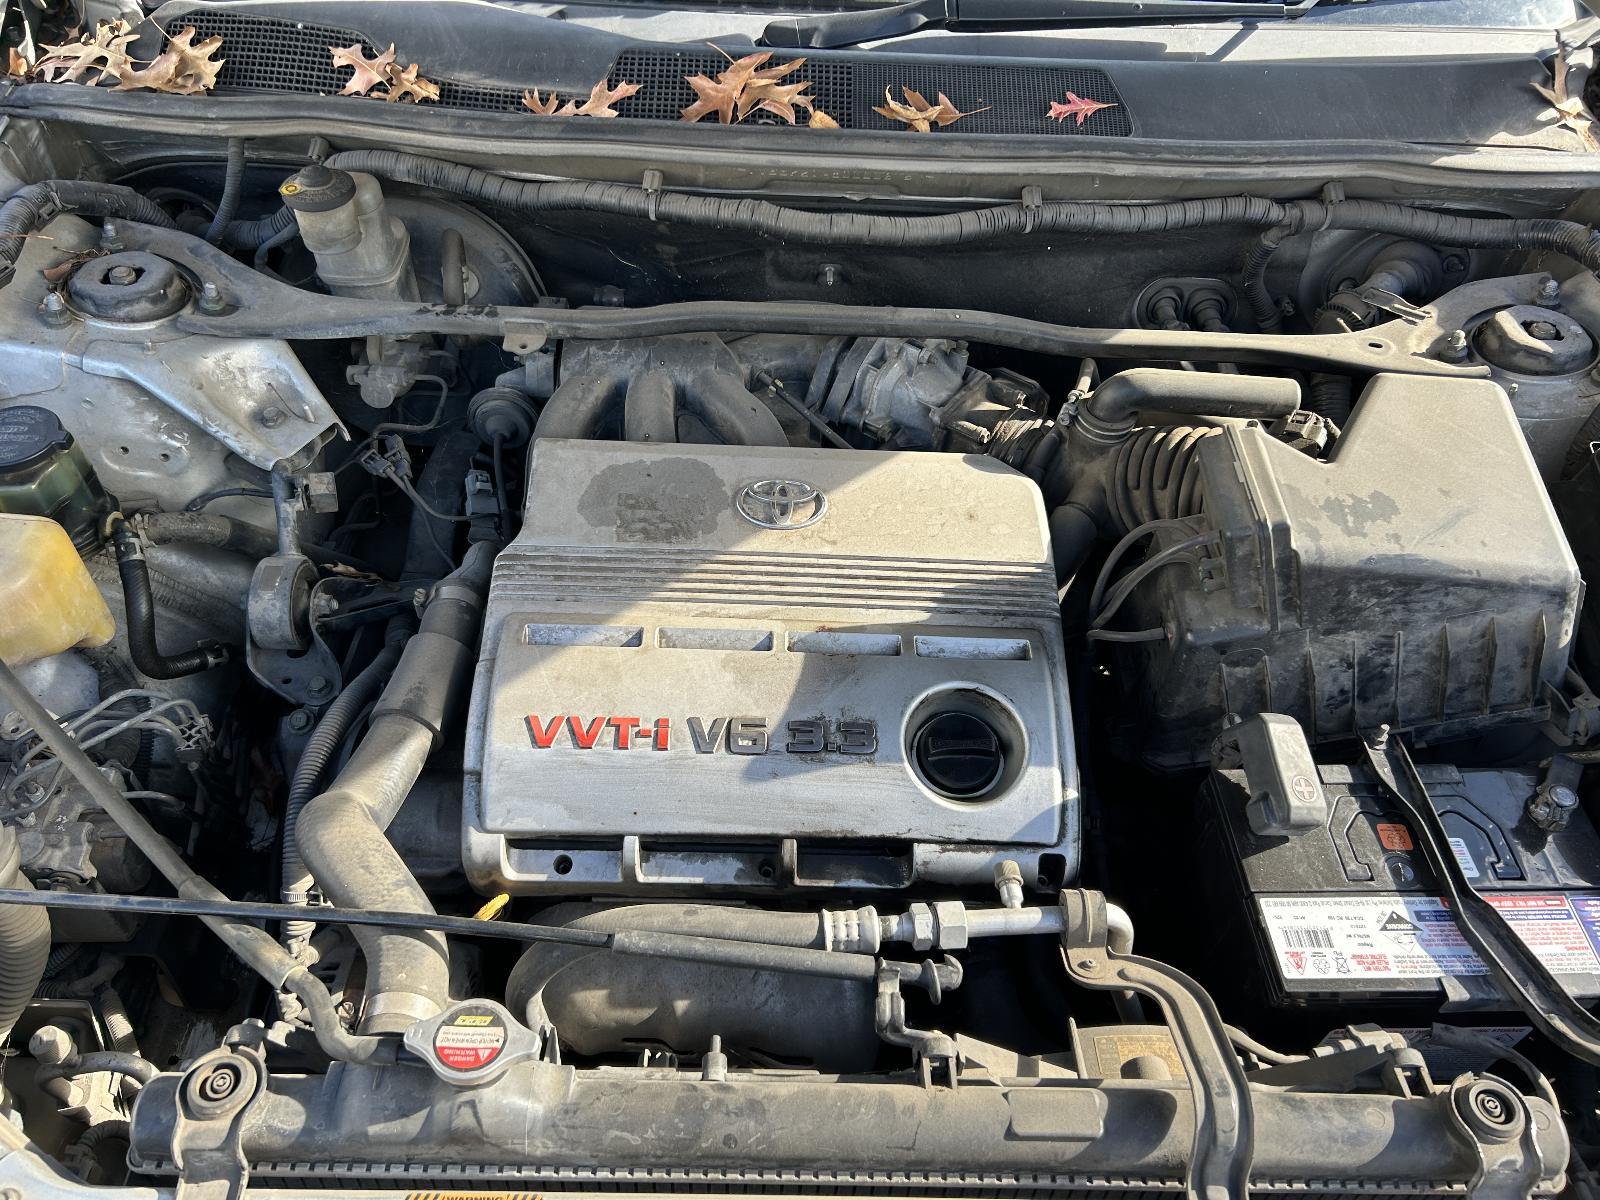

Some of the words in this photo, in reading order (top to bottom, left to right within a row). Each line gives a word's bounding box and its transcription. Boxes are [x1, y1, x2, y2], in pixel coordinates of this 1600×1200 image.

[524, 715, 671, 751] VVT-i
[686, 716, 769, 755] V6
[786, 719, 878, 755] 3.3
